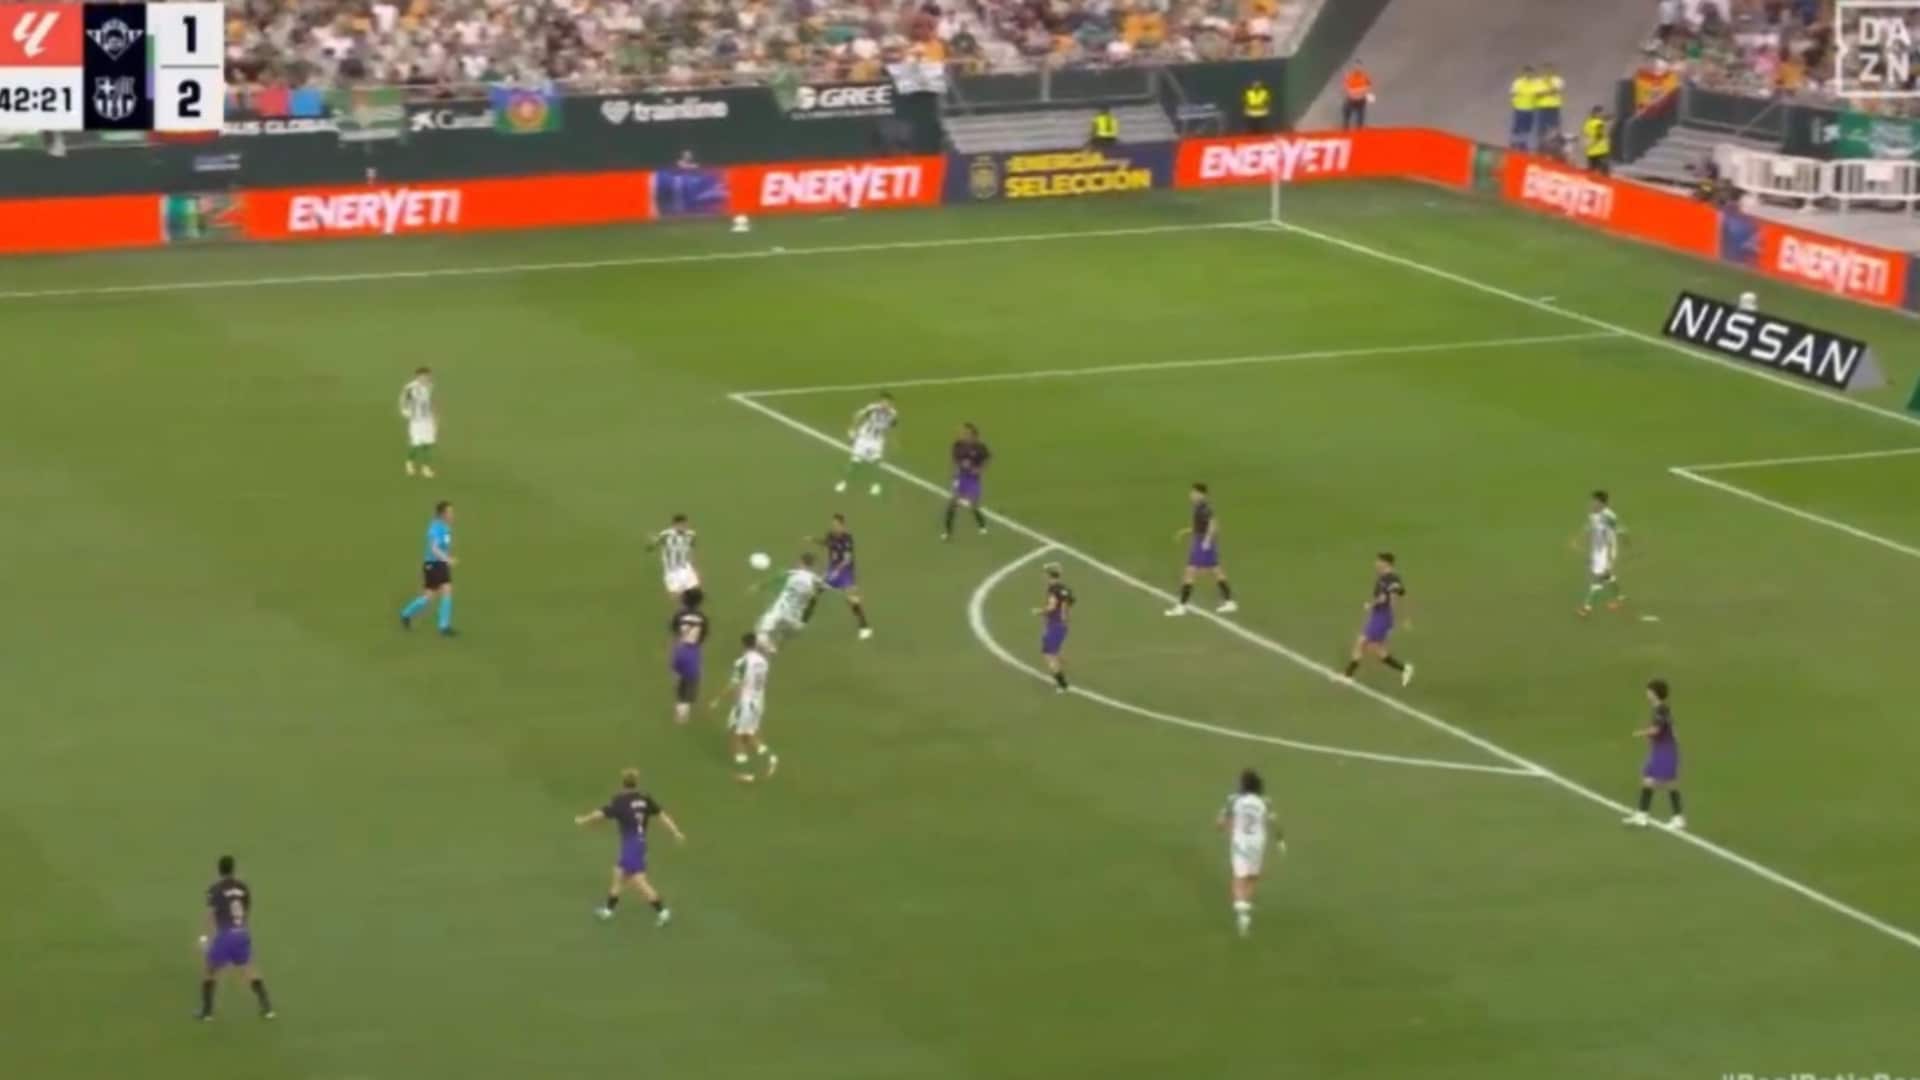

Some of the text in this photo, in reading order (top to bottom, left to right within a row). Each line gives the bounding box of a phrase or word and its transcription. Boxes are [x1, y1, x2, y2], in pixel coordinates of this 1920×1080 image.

[633, 97, 729, 122] trainline
[819, 85, 893, 108] GREE
[1201, 137, 1351, 181] ENERYETI
[761, 165, 921, 209] ENERYETI
[1523, 165, 1614, 220] ENERYETI
[289, 188, 460, 234] ENERYETI
[1777, 235, 1890, 294] ENERYETI
[1669, 298, 1859, 383] NISSAN
